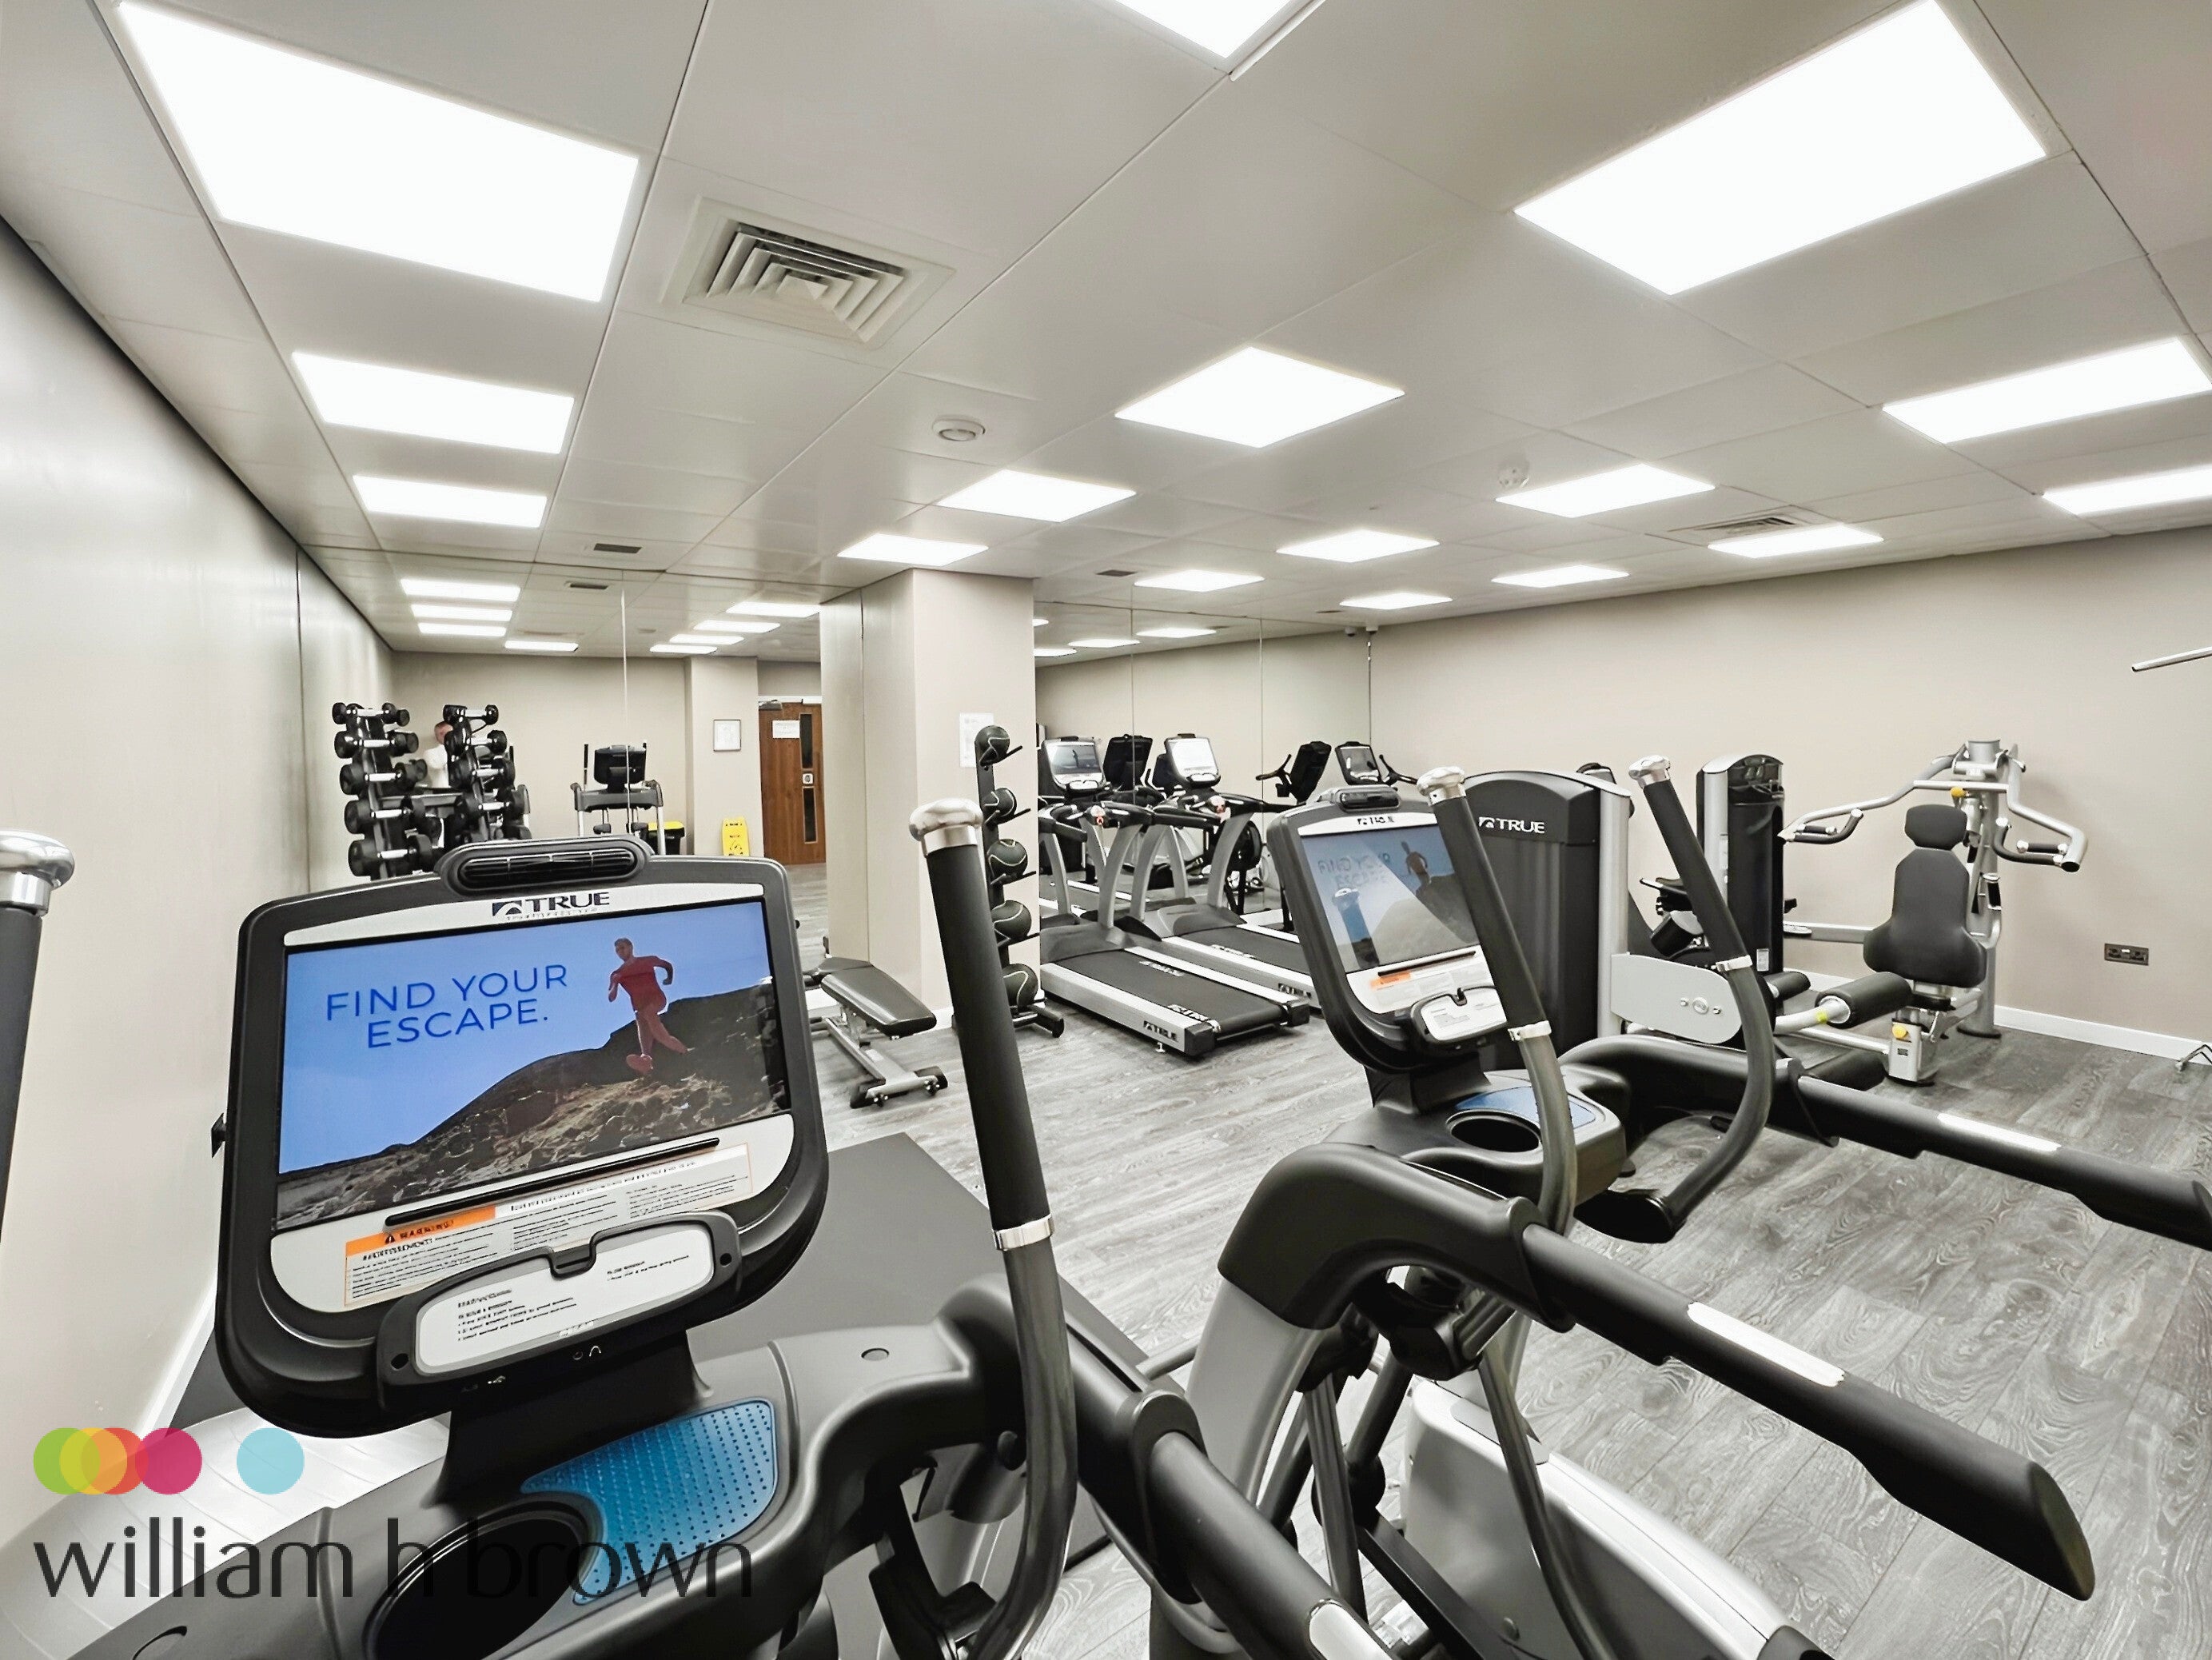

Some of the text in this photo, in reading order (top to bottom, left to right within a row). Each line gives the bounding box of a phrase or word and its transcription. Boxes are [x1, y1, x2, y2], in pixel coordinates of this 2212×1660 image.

[1496, 818, 1545, 834] TRUE
[525, 892, 610, 912] TRUE
[327, 964, 567, 1021] FIND YOUR
[368, 998, 548, 1048] ESCAPE.
